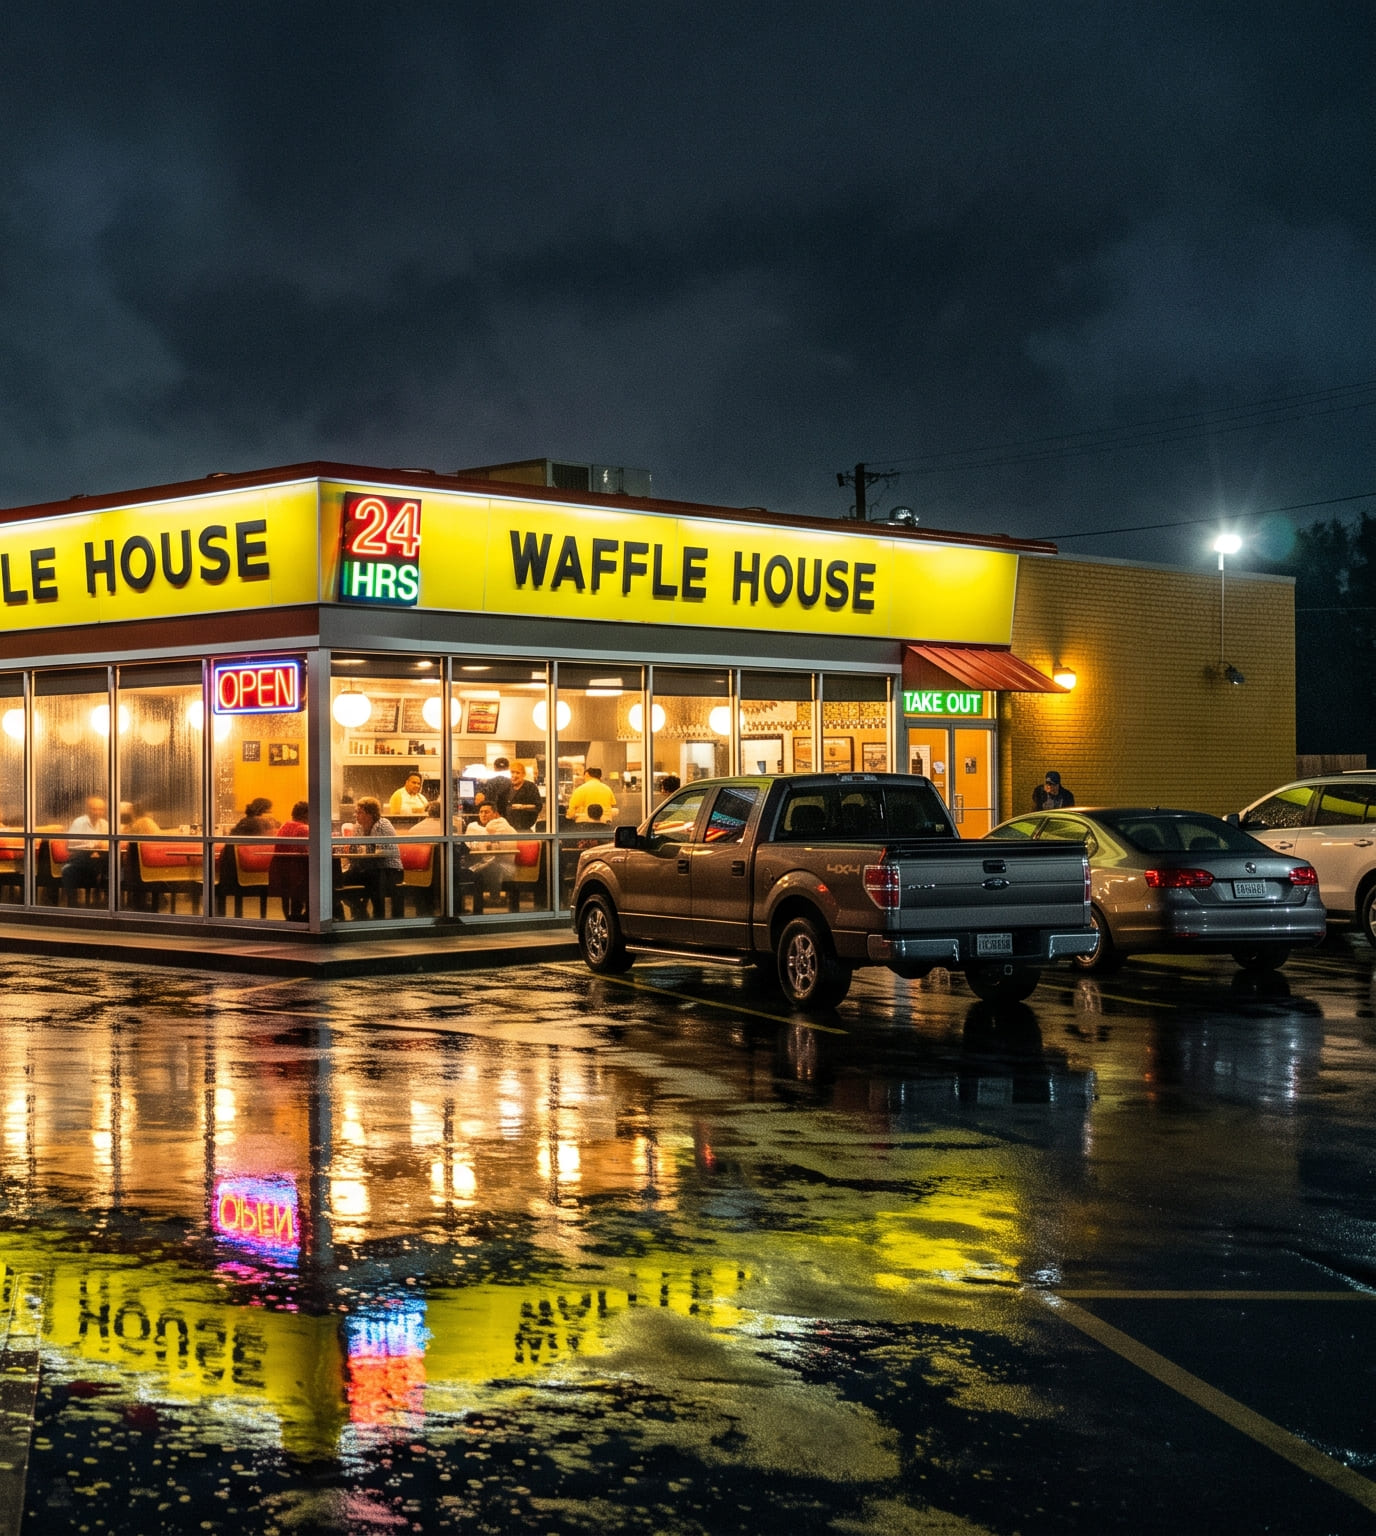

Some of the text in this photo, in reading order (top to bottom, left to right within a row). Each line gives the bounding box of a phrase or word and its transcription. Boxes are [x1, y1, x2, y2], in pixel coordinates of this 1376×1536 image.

[352, 498, 421, 556] 24
[84, 518, 270, 595] HOUSE
[351, 561, 419, 601] HRS
[509, 530, 876, 611] WAFFLE HOUSE
[219, 667, 294, 708] OPEN
[904, 692, 981, 713] TAKE OUT
